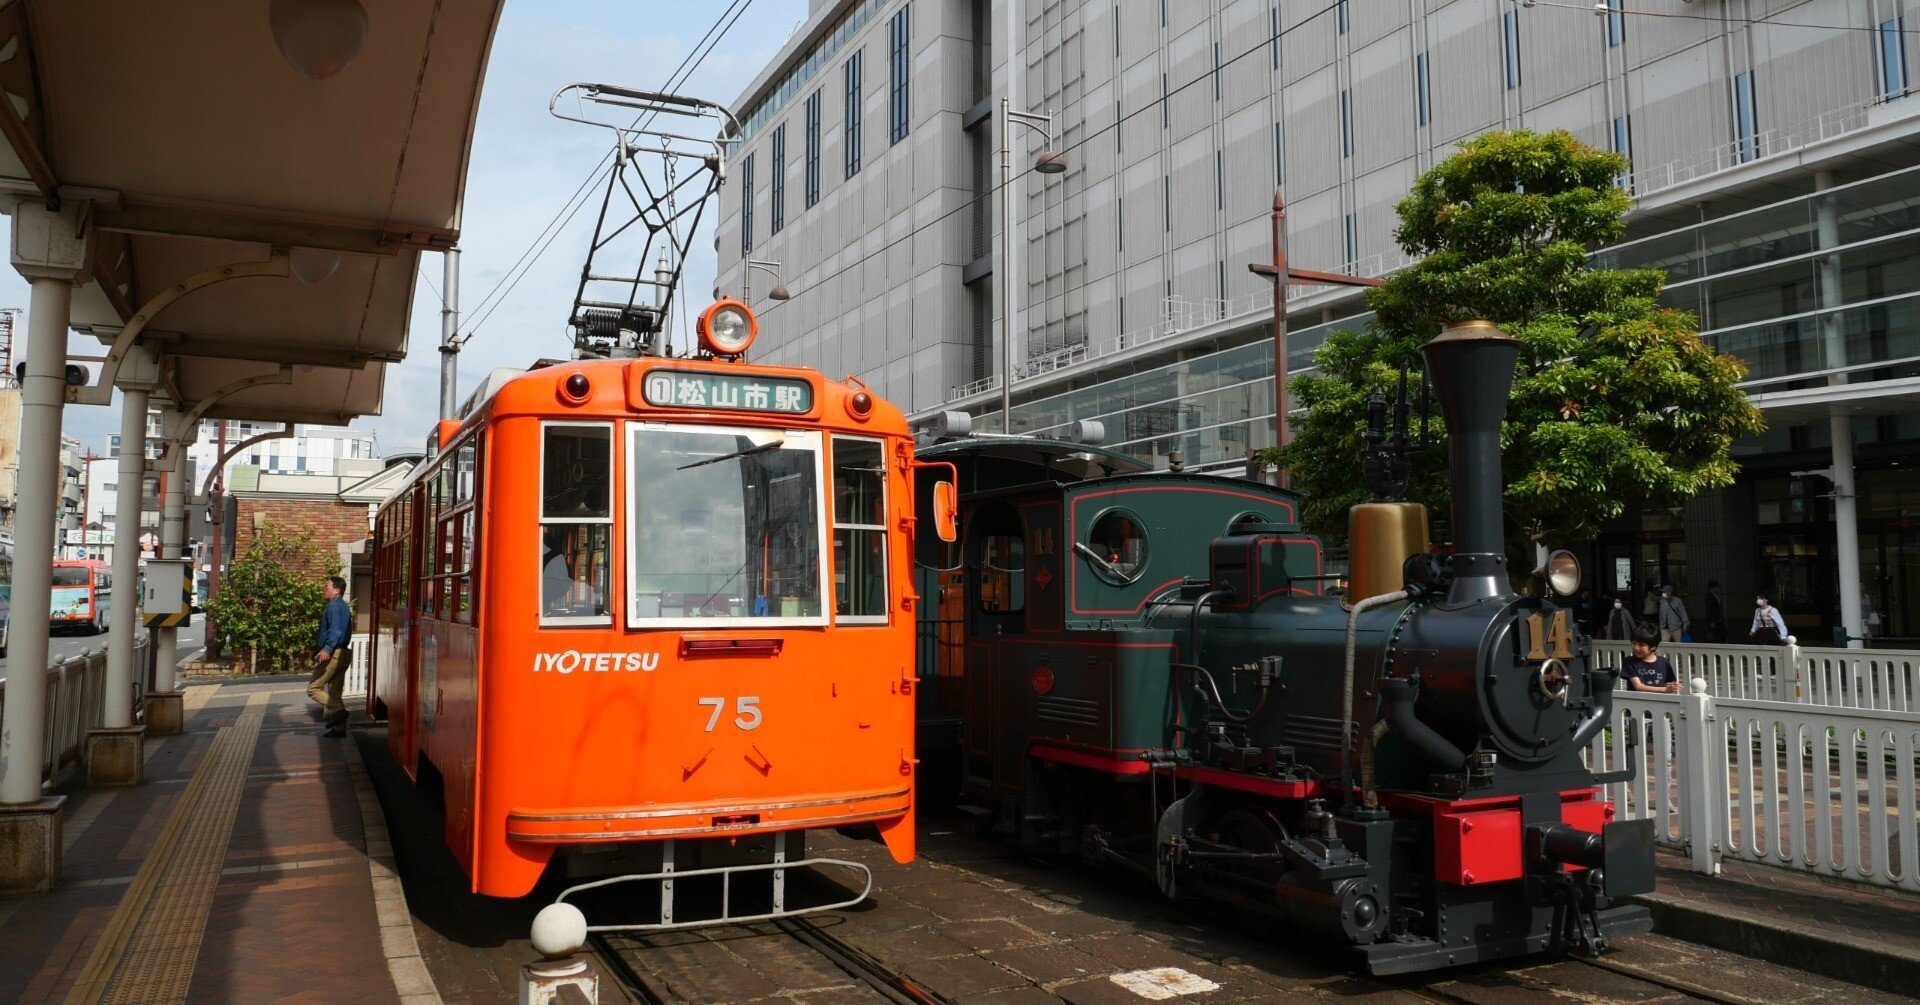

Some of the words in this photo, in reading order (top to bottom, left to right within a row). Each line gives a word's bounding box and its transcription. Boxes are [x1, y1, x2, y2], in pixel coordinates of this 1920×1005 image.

[678, 378, 801, 411] 松山市駅
[1526, 609, 1574, 659] 14
[533, 650, 660, 674] IYOTETSU
[698, 696, 762, 732] 75
